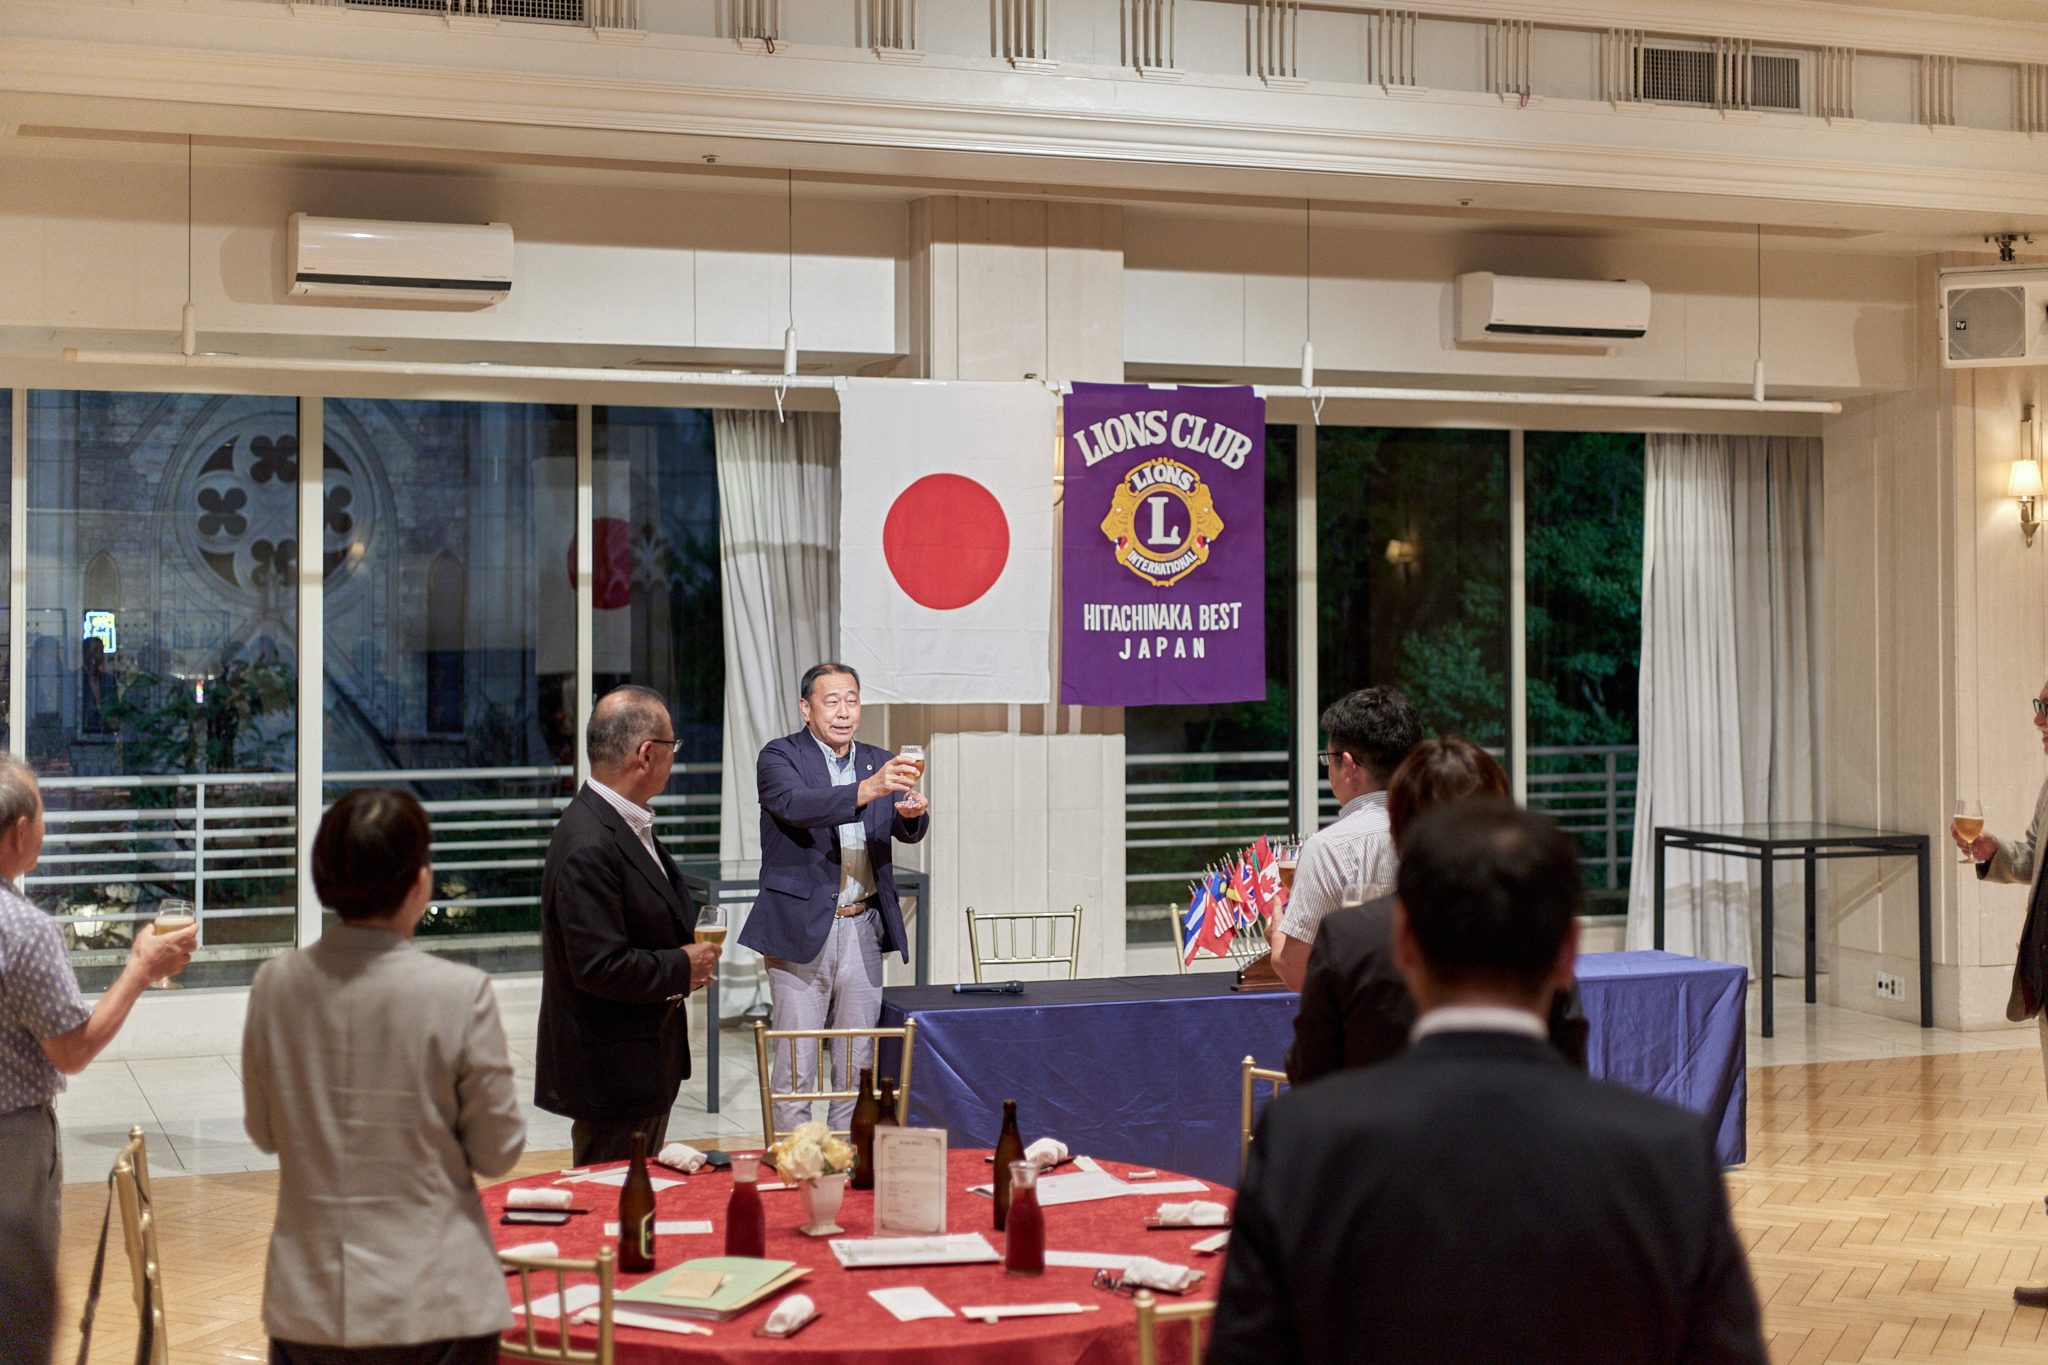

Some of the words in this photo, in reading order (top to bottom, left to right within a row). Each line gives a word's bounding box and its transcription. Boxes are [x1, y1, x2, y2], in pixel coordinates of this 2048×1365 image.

[1073, 410, 1168, 467] LIONS
[1171, 412, 1253, 470] CLUB
[1131, 463, 1195, 491] LIONS
[1147, 496, 1181, 545] L
[1126, 549, 1199, 576] INTERNATIONAL
[1083, 603, 1193, 632] HITACHINAKA
[1199, 602, 1243, 631] BEST
[1118, 636, 1205, 660] JAPAN
